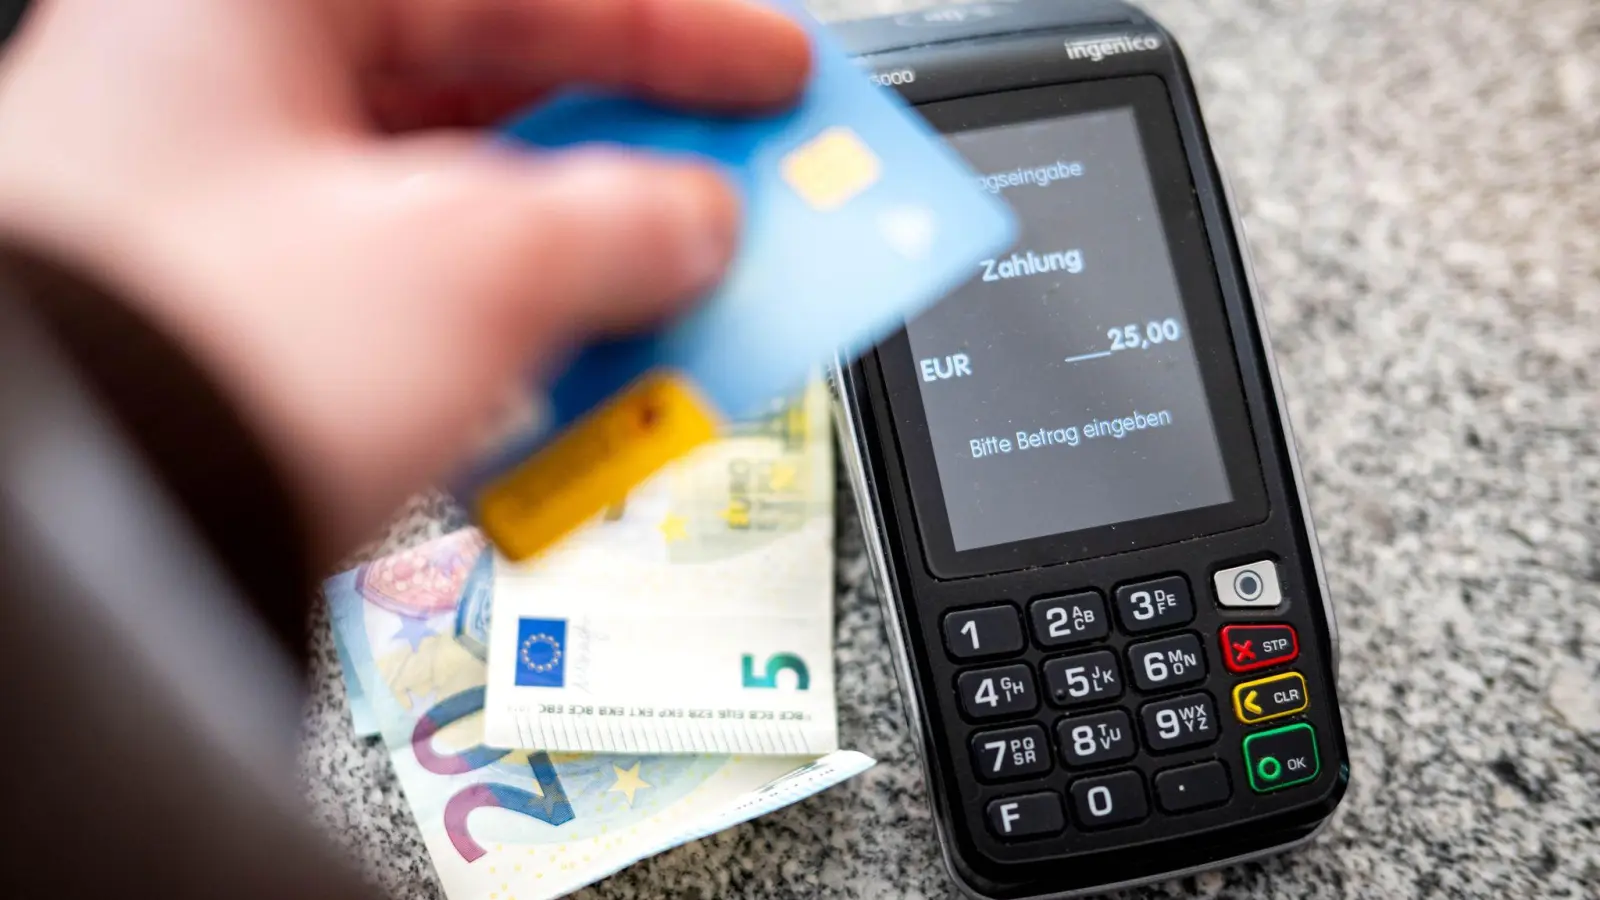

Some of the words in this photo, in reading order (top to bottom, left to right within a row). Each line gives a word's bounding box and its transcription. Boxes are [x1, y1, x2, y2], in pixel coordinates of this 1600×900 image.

[1064, 33, 1160, 62] ingenico
[980, 247, 1083, 285] Zahlung
[920, 353, 972, 383] EUR
[969, 434, 1012, 459] Bitte
[1015, 425, 1080, 451] Betrag
[1083, 409, 1172, 440] eingeben
[1130, 591, 1153, 621] 3
[960, 620, 980, 650] 1
[1046, 607, 1070, 638] 2
[1262, 638, 1288, 653] STP
[741, 651, 811, 692] 5
[1143, 652, 1168, 682] 6
[974, 678, 999, 708] 4
[1065, 667, 1088, 698] 5
[1273, 690, 1300, 704] CLR
[1155, 709, 1181, 740] 9
[1071, 725, 1097, 756] 8
[984, 740, 1007, 772] 7
[1286, 755, 1307, 771] OK
[1087, 786, 1112, 816] 0
[1000, 803, 1020, 833] F
